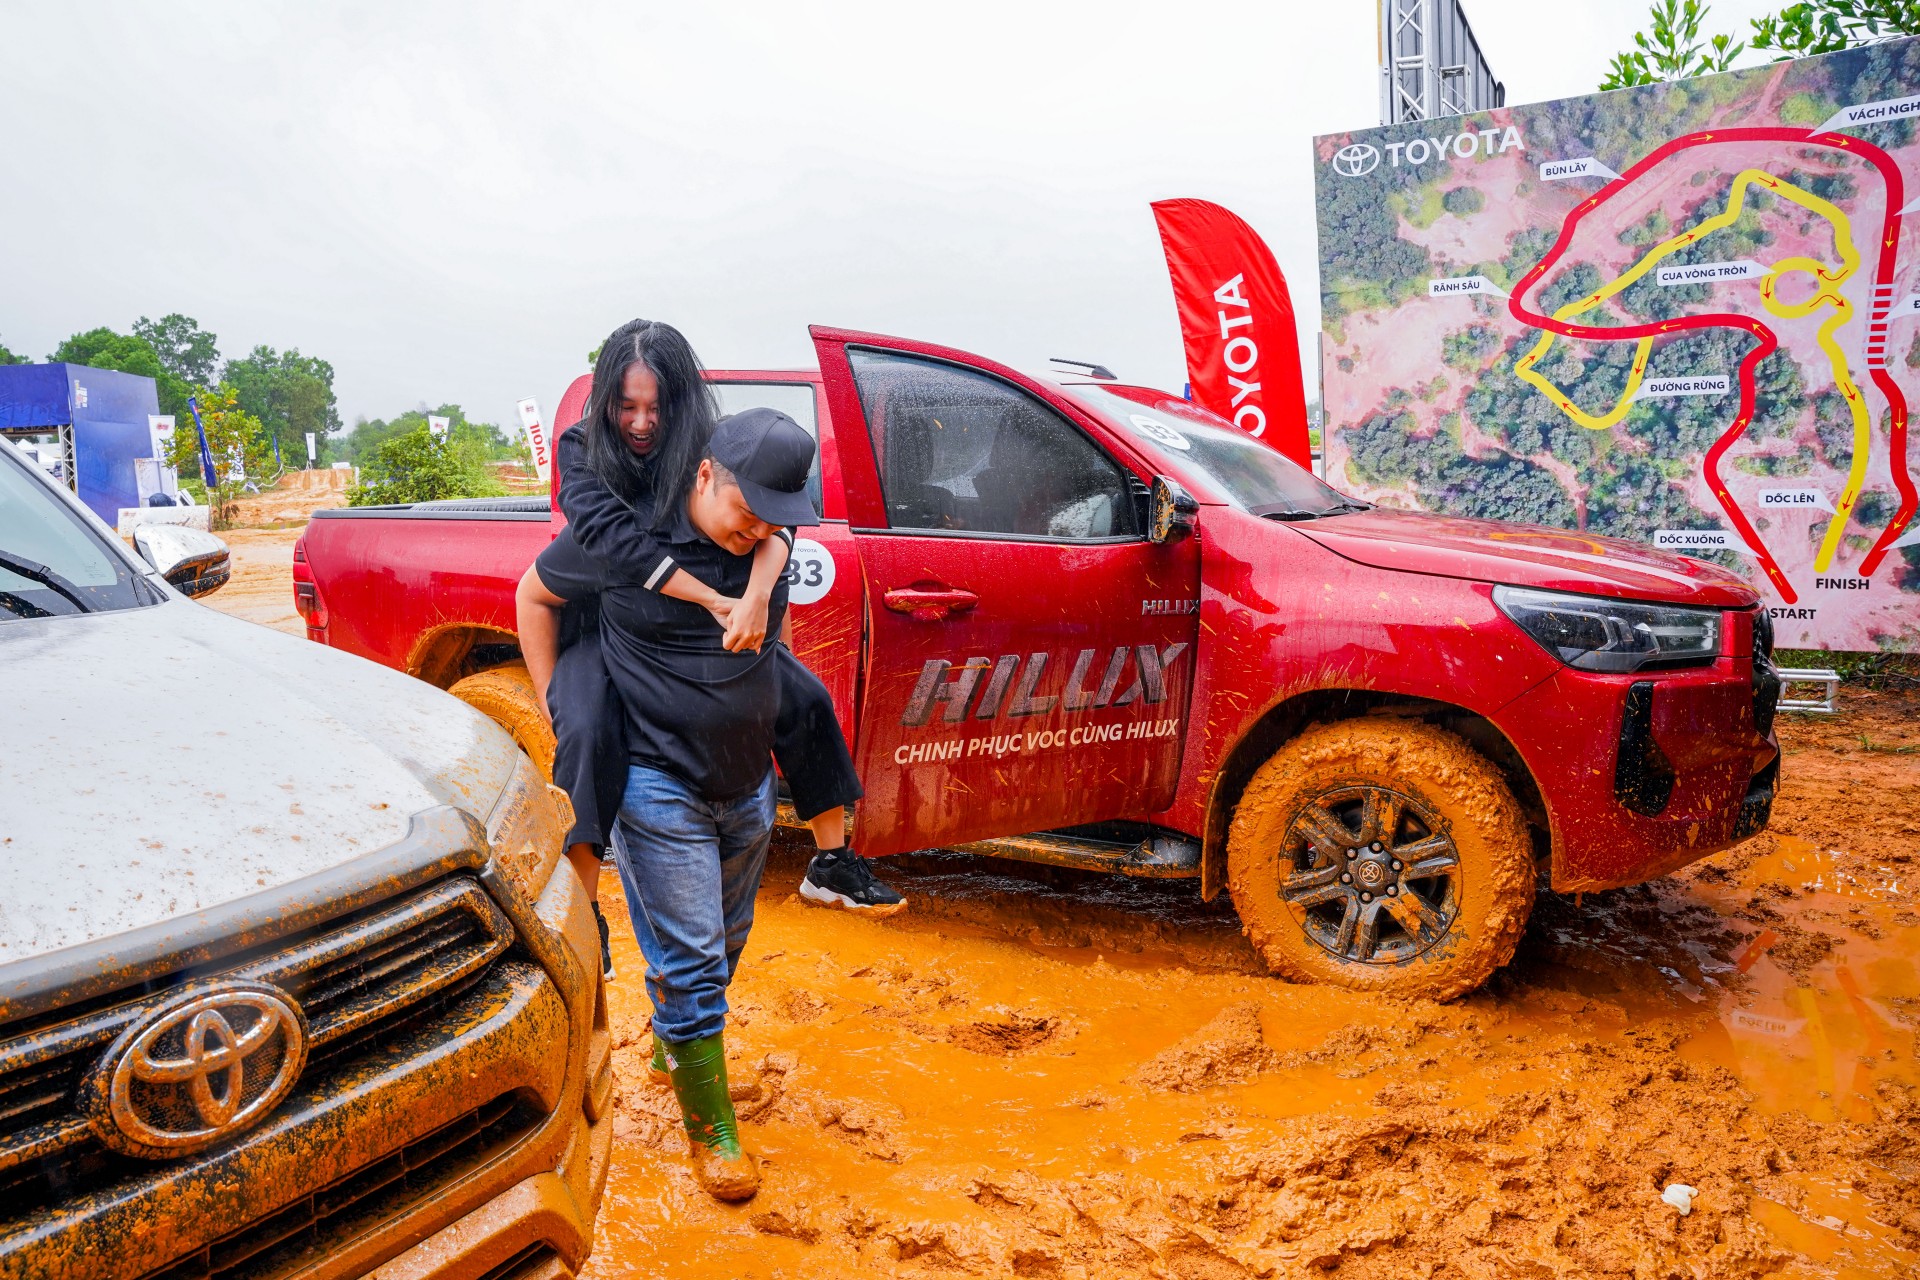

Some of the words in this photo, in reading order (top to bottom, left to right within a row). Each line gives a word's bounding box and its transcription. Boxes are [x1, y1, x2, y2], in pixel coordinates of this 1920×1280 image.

[1849, 107, 1885, 121] VÁCH
[1385, 126, 1525, 167] TOYOTA
[1546, 165, 1567, 176] BÙN
[1662, 272, 1683, 281] CUA
[1685, 269, 1716, 279] VÒNG
[1718, 265, 1747, 276] TRÒN
[1434, 282, 1460, 292] RÃNH
[1462, 280, 1480, 290] SÂU
[1650, 382, 1691, 392] ĐƯỜNG
[1693, 380, 1725, 391] RỪNG
[530, 421, 548, 466] PVOIL
[1765, 492, 1790, 503] DỐC
[1793, 492, 1815, 503] LÊN
[1660, 533, 1683, 544] DỐC
[1685, 533, 1725, 544] XUỐNG
[1816, 578, 1870, 590] FINISH
[1142, 599, 1200, 616] HILUX
[1770, 608, 1817, 620] START
[901, 642, 1188, 727] HILUX
[895, 739, 965, 765] CHINH
[967, 733, 1023, 759] PHỤC
[1027, 728, 1067, 751] VOC
[1070, 721, 1123, 745] CÙNG
[1126, 718, 1179, 739] HILUX
